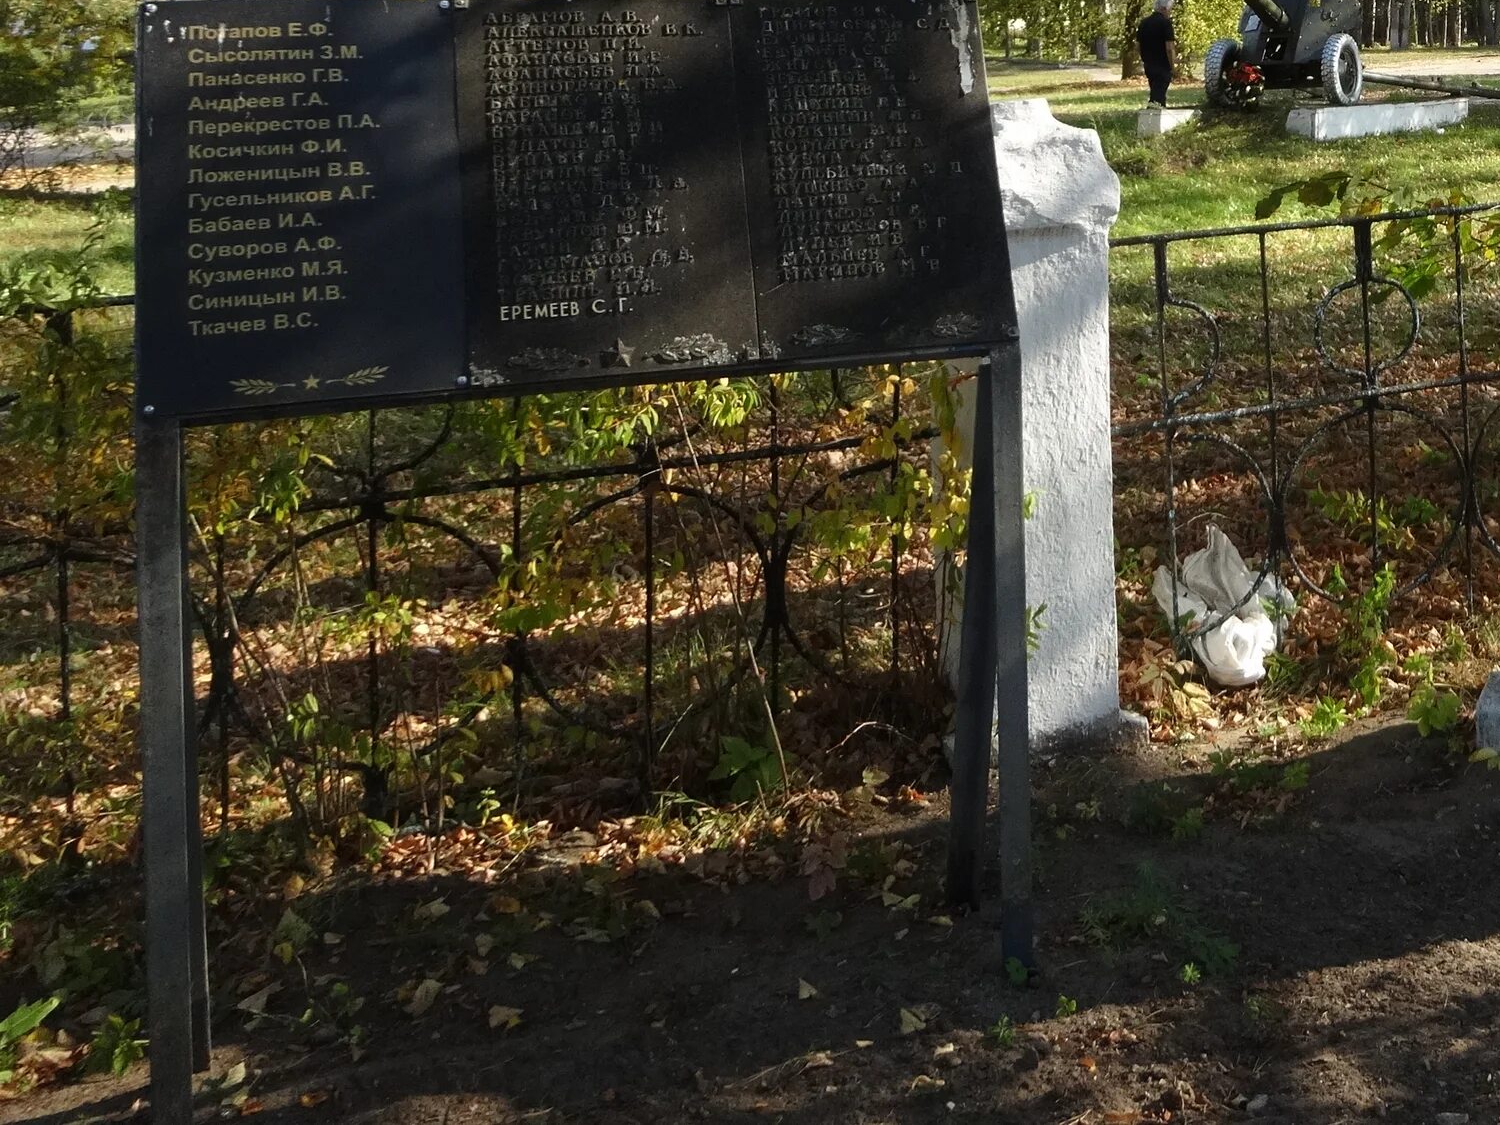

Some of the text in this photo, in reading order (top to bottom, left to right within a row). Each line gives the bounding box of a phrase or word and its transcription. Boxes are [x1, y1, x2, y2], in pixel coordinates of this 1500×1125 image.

[189, 24, 282, 40] Потапов
[189, 47, 314, 64] Сысолятин
[189, 72, 306, 87] Панасенко
[189, 96, 284, 113] Андреев
[189, 118, 330, 136] Перекрестов
[189, 143, 294, 159] Косичкин
[188, 165, 320, 184] Ложеницын
[189, 190, 332, 210] Гусельников
[189, 218, 271, 234] Бабаев
[189, 241, 287, 261] Суворов
[189, 265, 294, 286] Кузменко
[189, 291, 295, 310] Синицын
[500, 301, 580, 321] ЕРЕМЕЕВ
[189, 319, 266, 336] Ткачев
